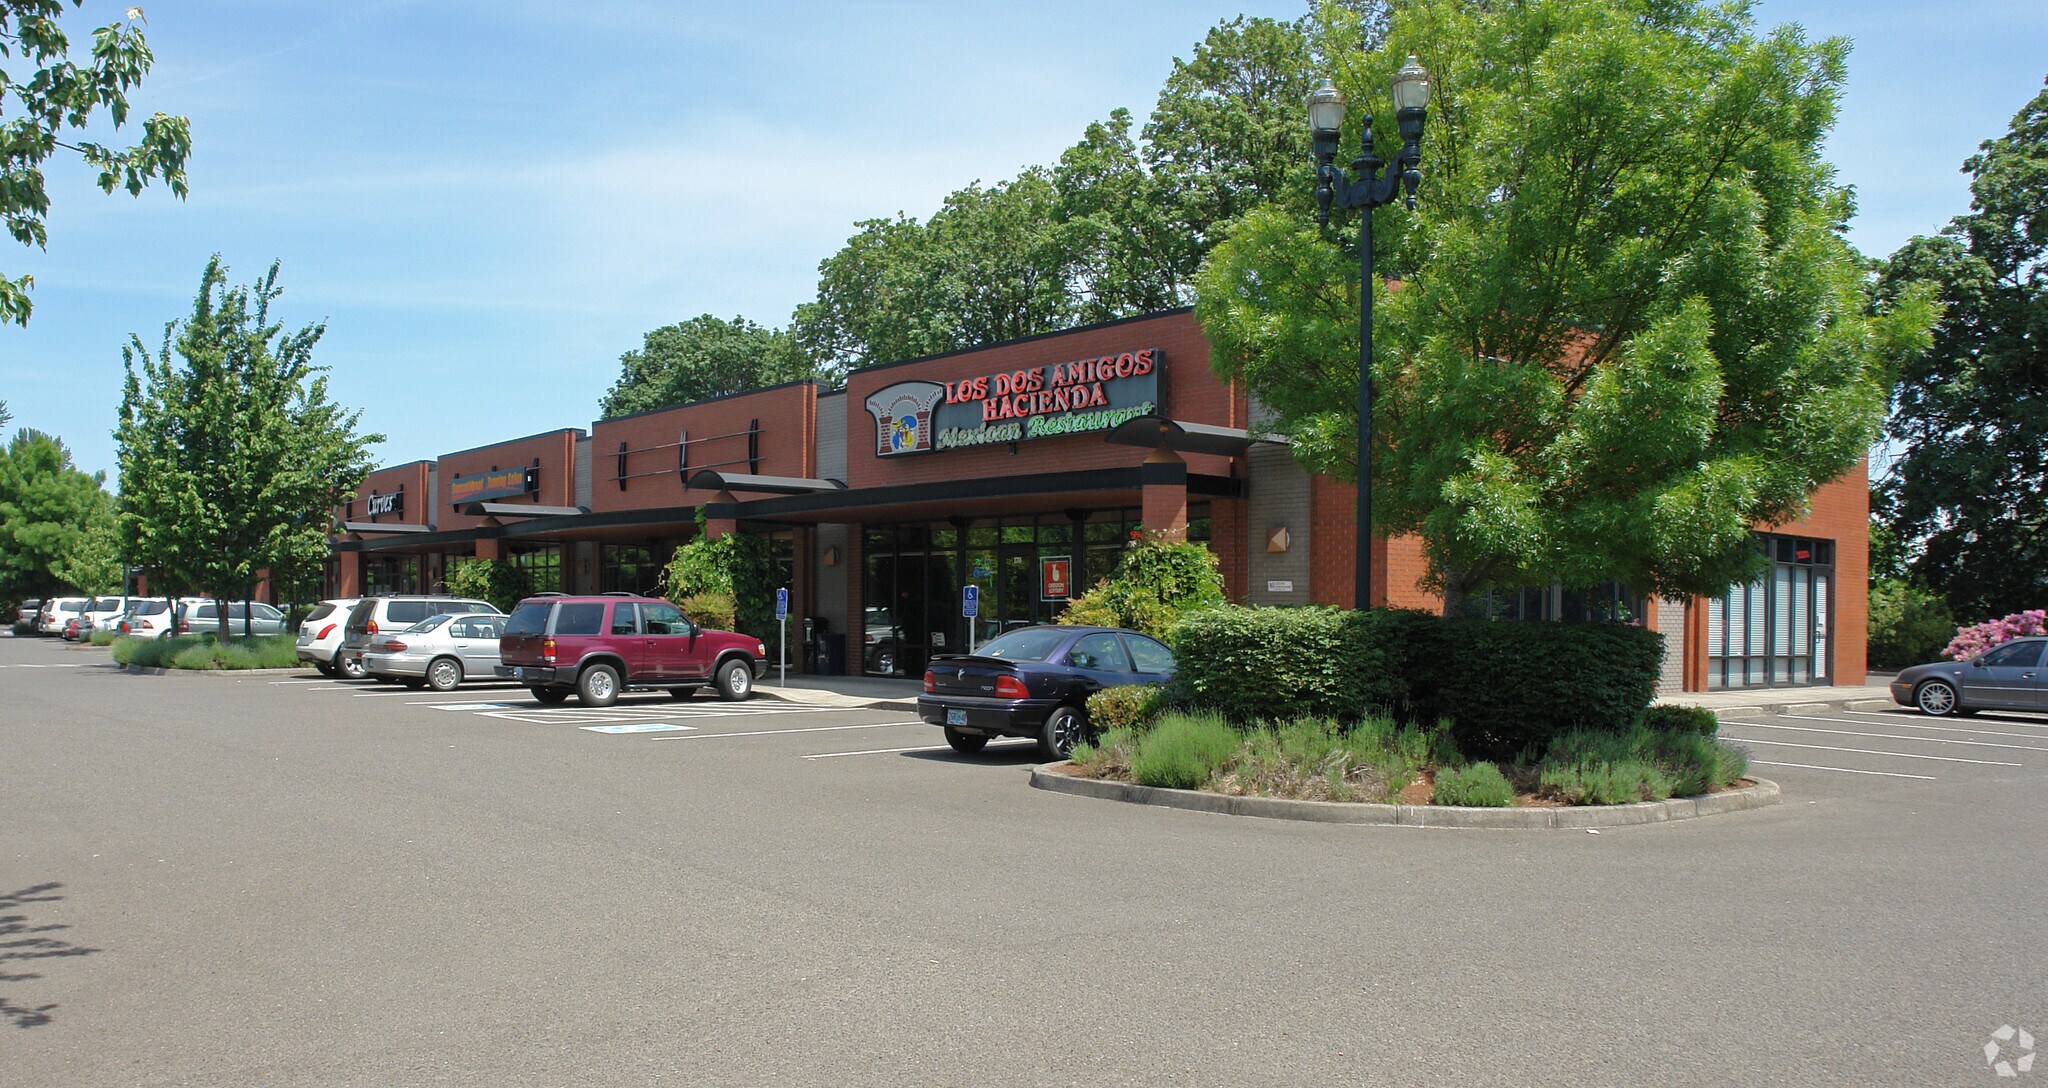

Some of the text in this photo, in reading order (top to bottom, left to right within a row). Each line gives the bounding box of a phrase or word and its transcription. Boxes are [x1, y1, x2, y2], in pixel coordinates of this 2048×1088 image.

[945, 349, 1154, 404] LOS DOS AMIGOS
[982, 381, 1108, 421] HACIENDA
[936, 401, 1155, 449] Mexican Restaurant
[367, 494, 393, 516] Curves
